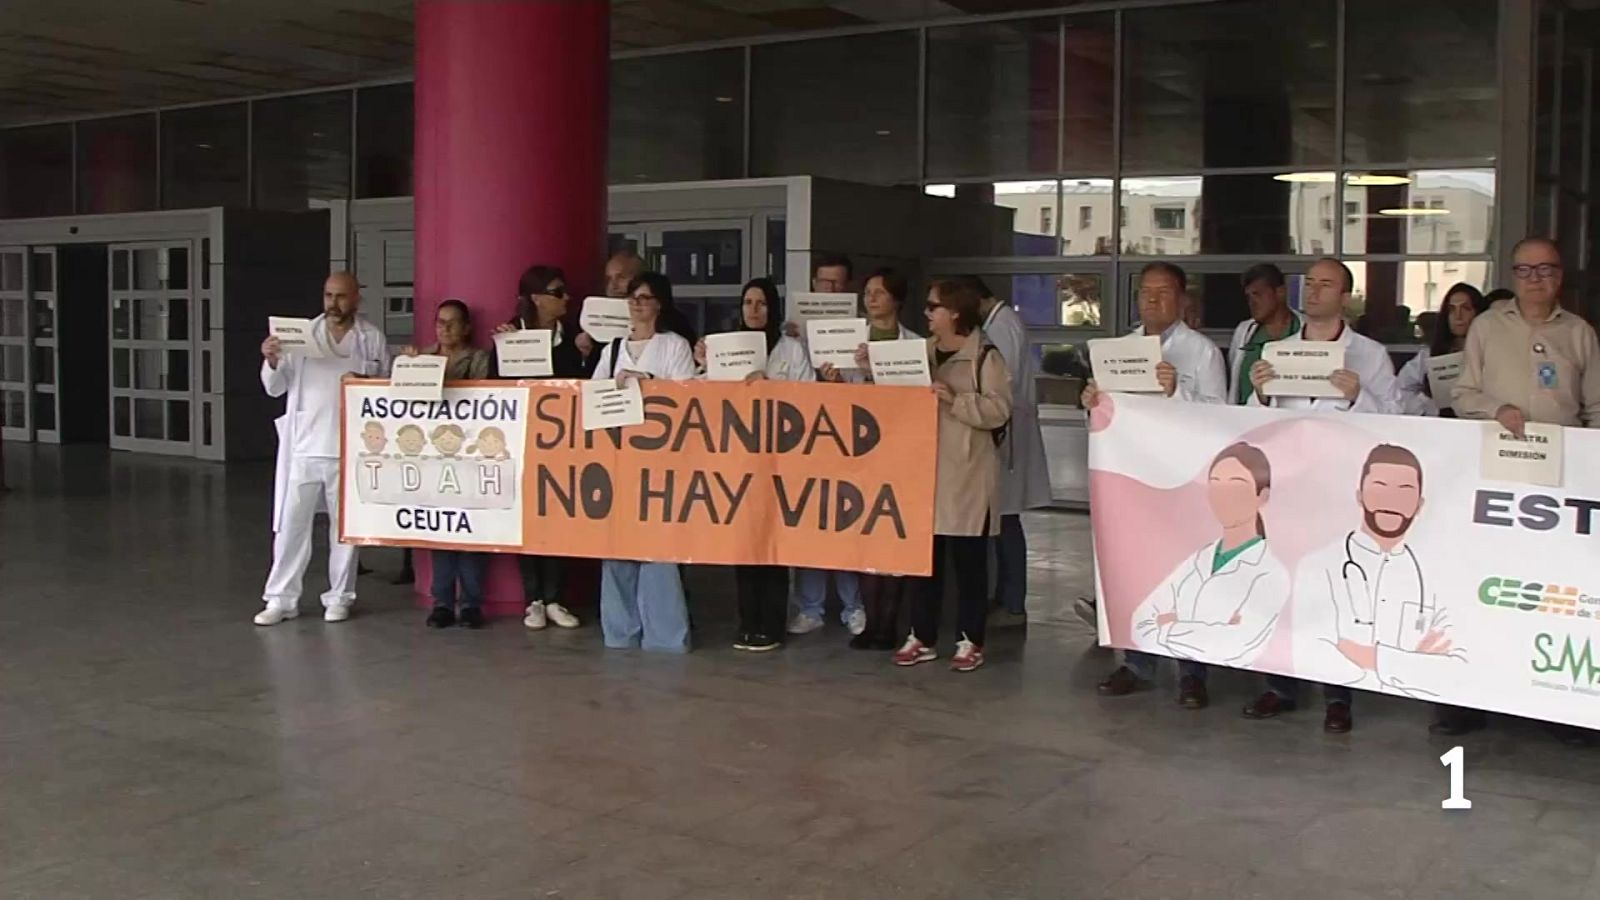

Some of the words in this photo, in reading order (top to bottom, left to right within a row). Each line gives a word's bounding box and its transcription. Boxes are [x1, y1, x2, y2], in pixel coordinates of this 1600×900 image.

[360, 394, 518, 421] ASOCIACIÓN
[629, 395, 881, 457] SANIDAD
[1499, 432, 1549, 444] MISTRA
[537, 462, 614, 521] NO
[639, 467, 754, 526] HAY
[771, 474, 907, 539] VIDA
[395, 507, 473, 534] CEUTA
